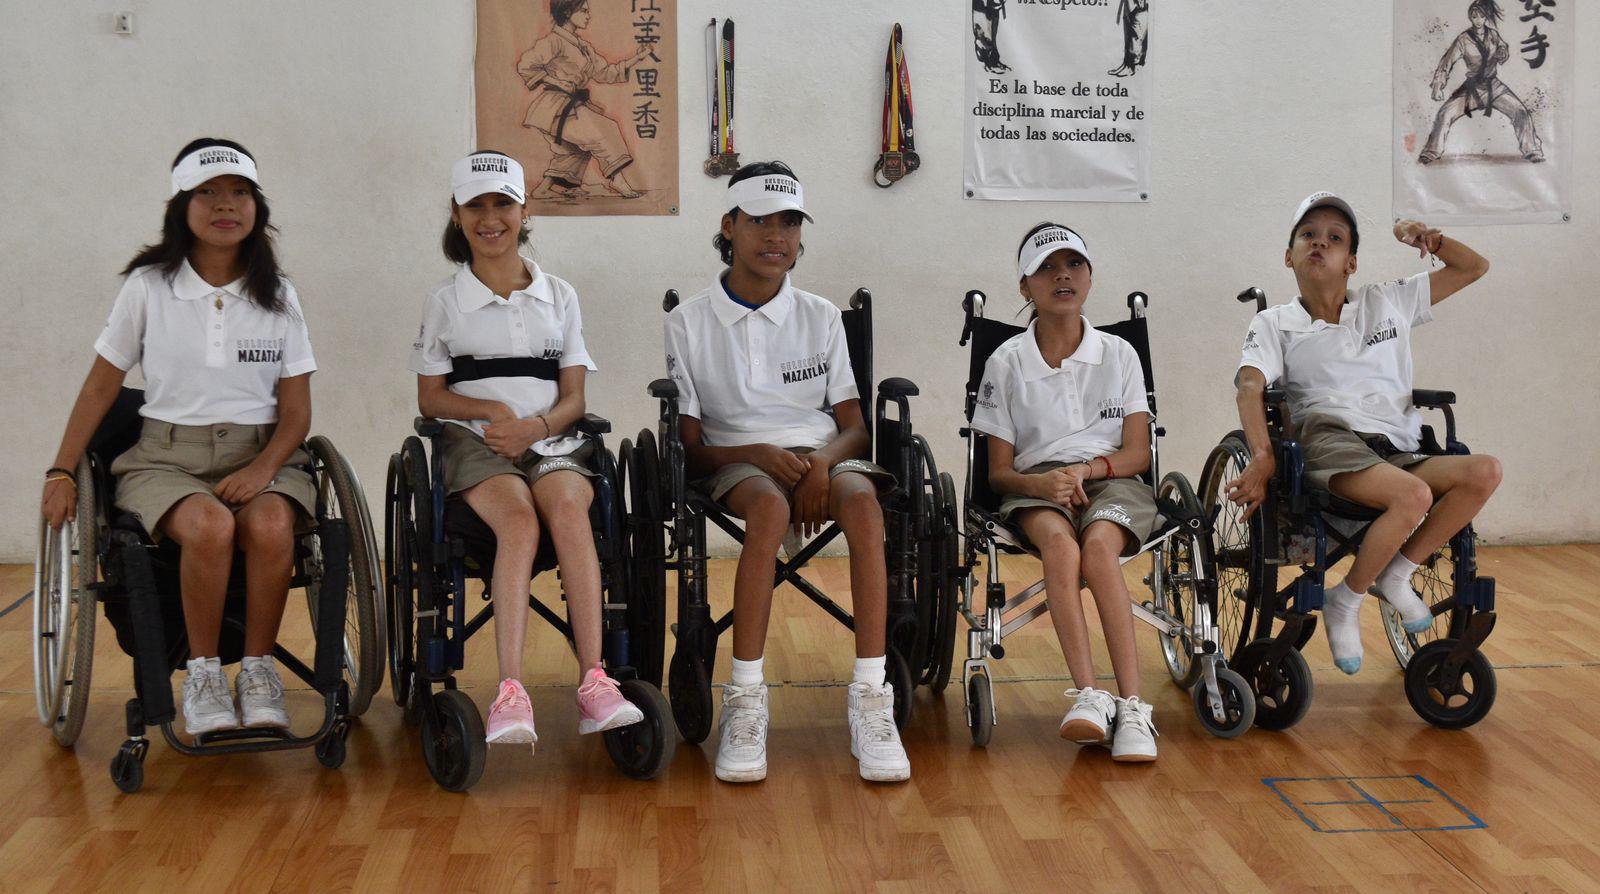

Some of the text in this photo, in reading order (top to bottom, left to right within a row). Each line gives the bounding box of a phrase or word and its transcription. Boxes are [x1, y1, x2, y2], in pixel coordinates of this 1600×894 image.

[988, 79, 1129, 98] Es la base de toda
[972, 102, 1145, 121] disciplina marcial y de
[980, 125, 1136, 142] todas las sociedades.
